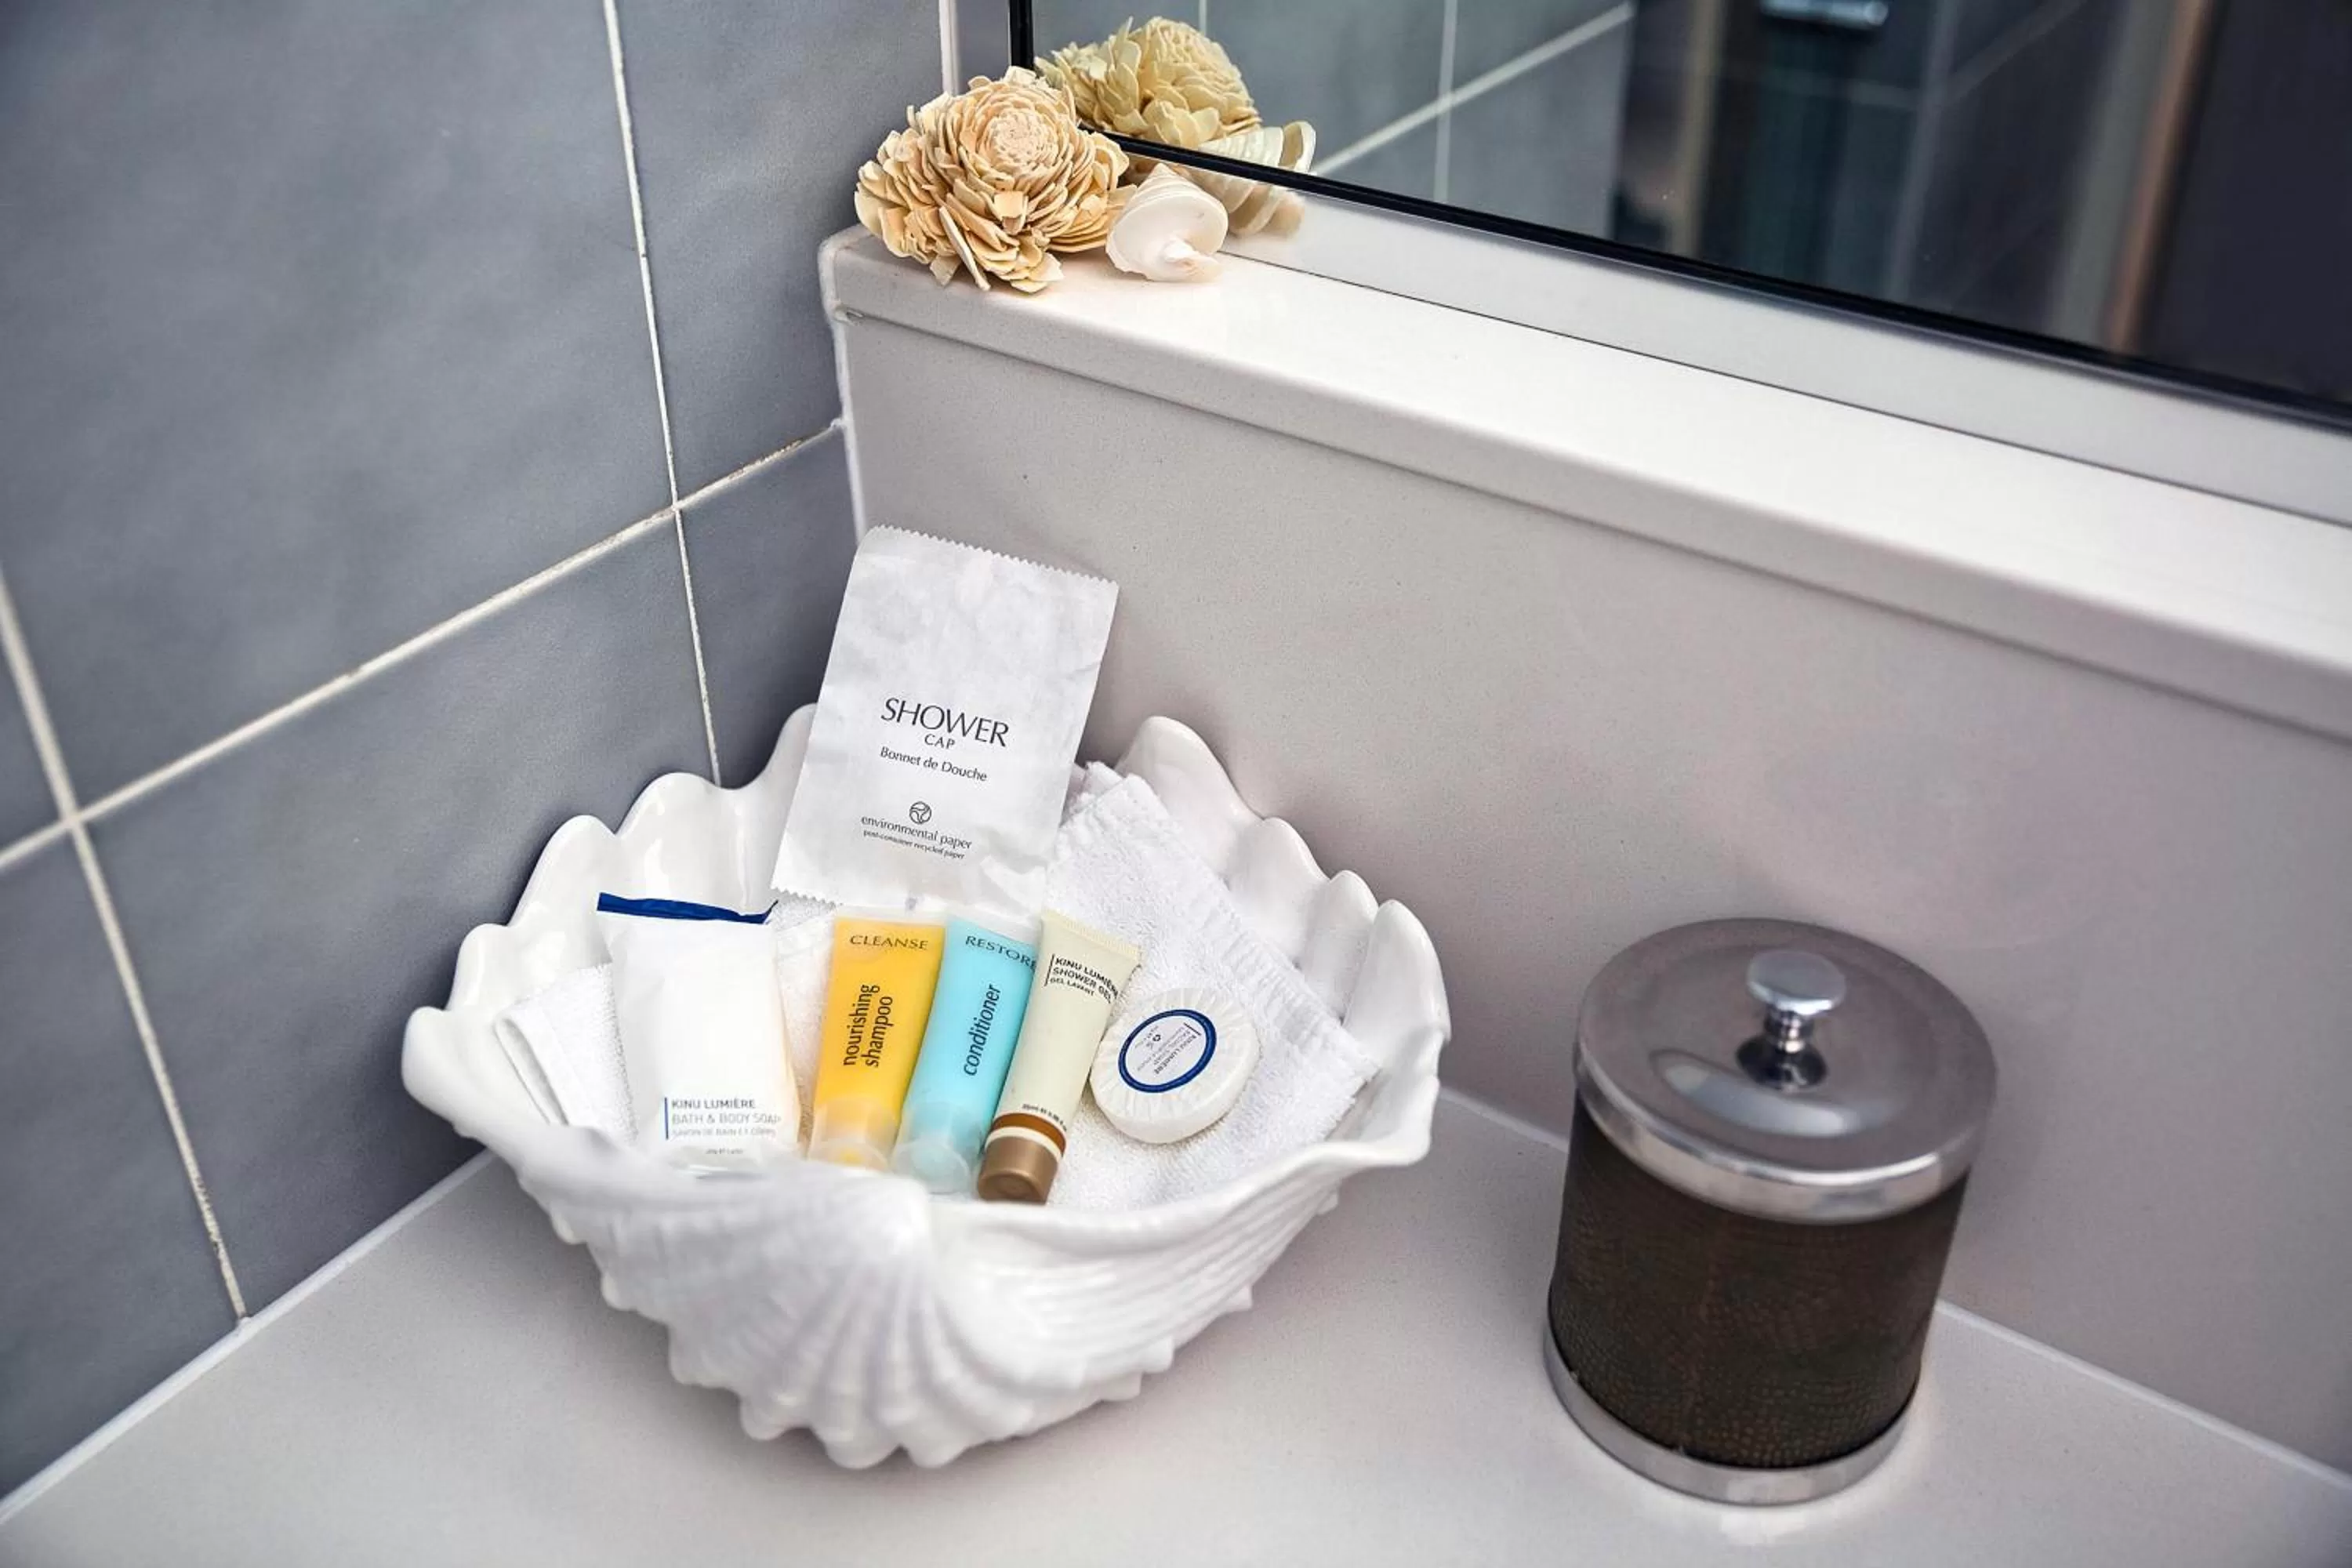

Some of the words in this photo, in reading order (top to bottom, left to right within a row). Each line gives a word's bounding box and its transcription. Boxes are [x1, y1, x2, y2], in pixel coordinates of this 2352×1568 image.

[880, 697, 1009, 747] SHOWER
[924, 733, 956, 750] CAP
[880, 746, 921, 766] Bonnet
[923, 757, 938, 771] de
[941, 761, 988, 782] Douche
[861, 816, 938, 841] environmental
[940, 834, 973, 850] paper
[850, 935, 928, 950] CLEANSE
[1053, 967, 1097, 988] SHOWER
[1055, 957, 1083, 971] KINU
[843, 984, 880, 1066] nourishing
[861, 996, 894, 1068] shampoo
[964, 983, 1001, 1076] conditioner
[671, 1098, 701, 1109] KINU
[672, 1113, 703, 1124] BATH
[706, 1114, 715, 1124] &
